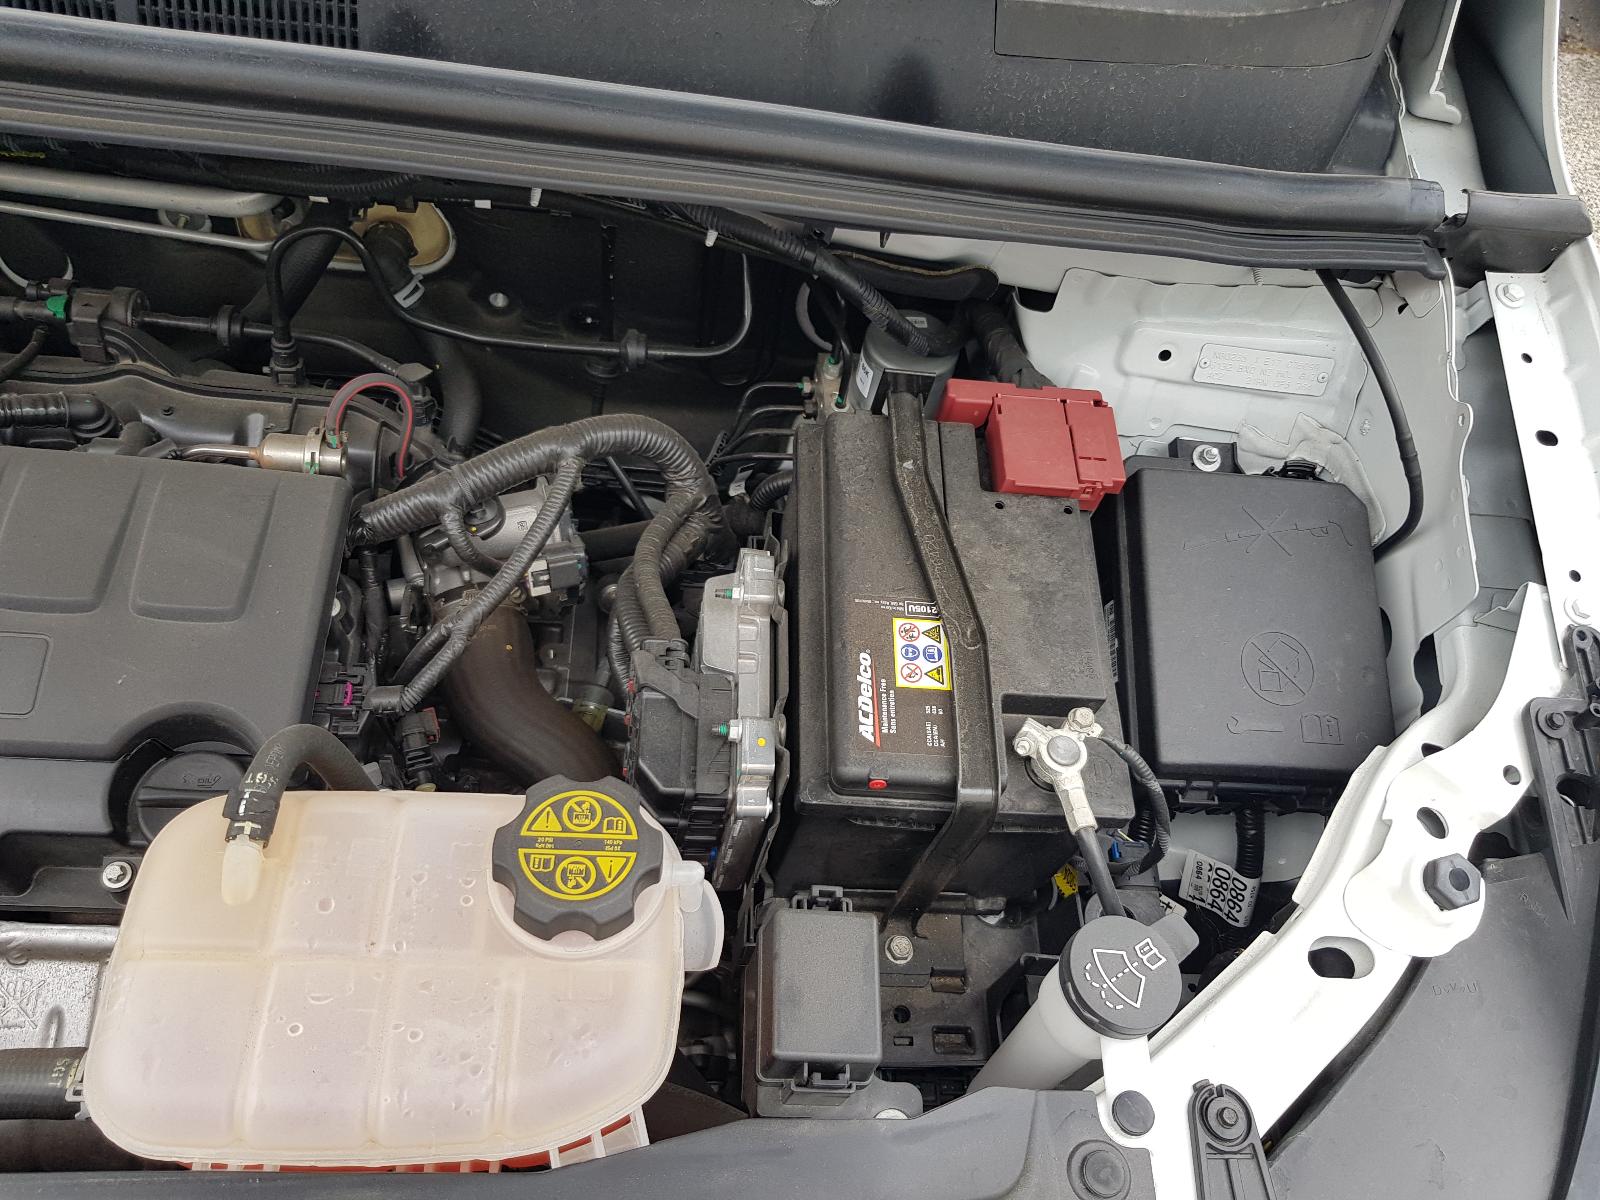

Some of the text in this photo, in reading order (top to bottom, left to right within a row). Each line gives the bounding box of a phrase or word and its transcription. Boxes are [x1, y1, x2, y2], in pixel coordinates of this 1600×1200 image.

[857, 651, 874, 743] ACDelco
[879, 679, 889, 734] Maintenance Free
[888, 690, 897, 734] Sans entretien
[1195, 861, 1203, 880] 0864
[1207, 867, 1231, 914] 0864
[1224, 876, 1248, 924] 0864
